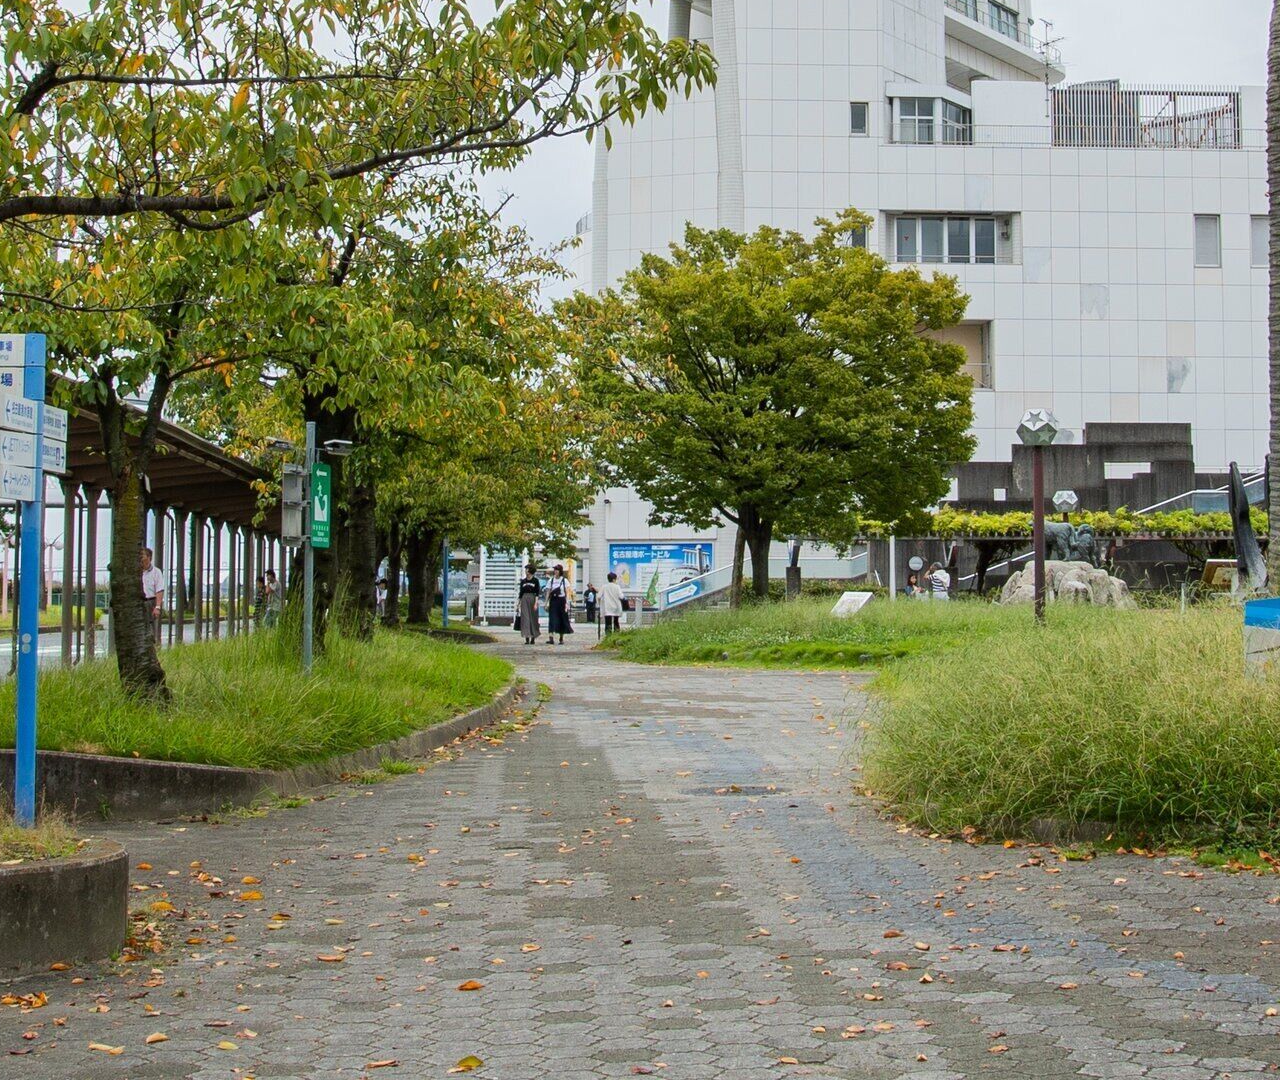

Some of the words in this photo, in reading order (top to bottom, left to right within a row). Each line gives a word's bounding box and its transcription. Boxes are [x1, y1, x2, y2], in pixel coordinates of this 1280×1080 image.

[613, 550, 670, 559] 名古屋港ポートビル
